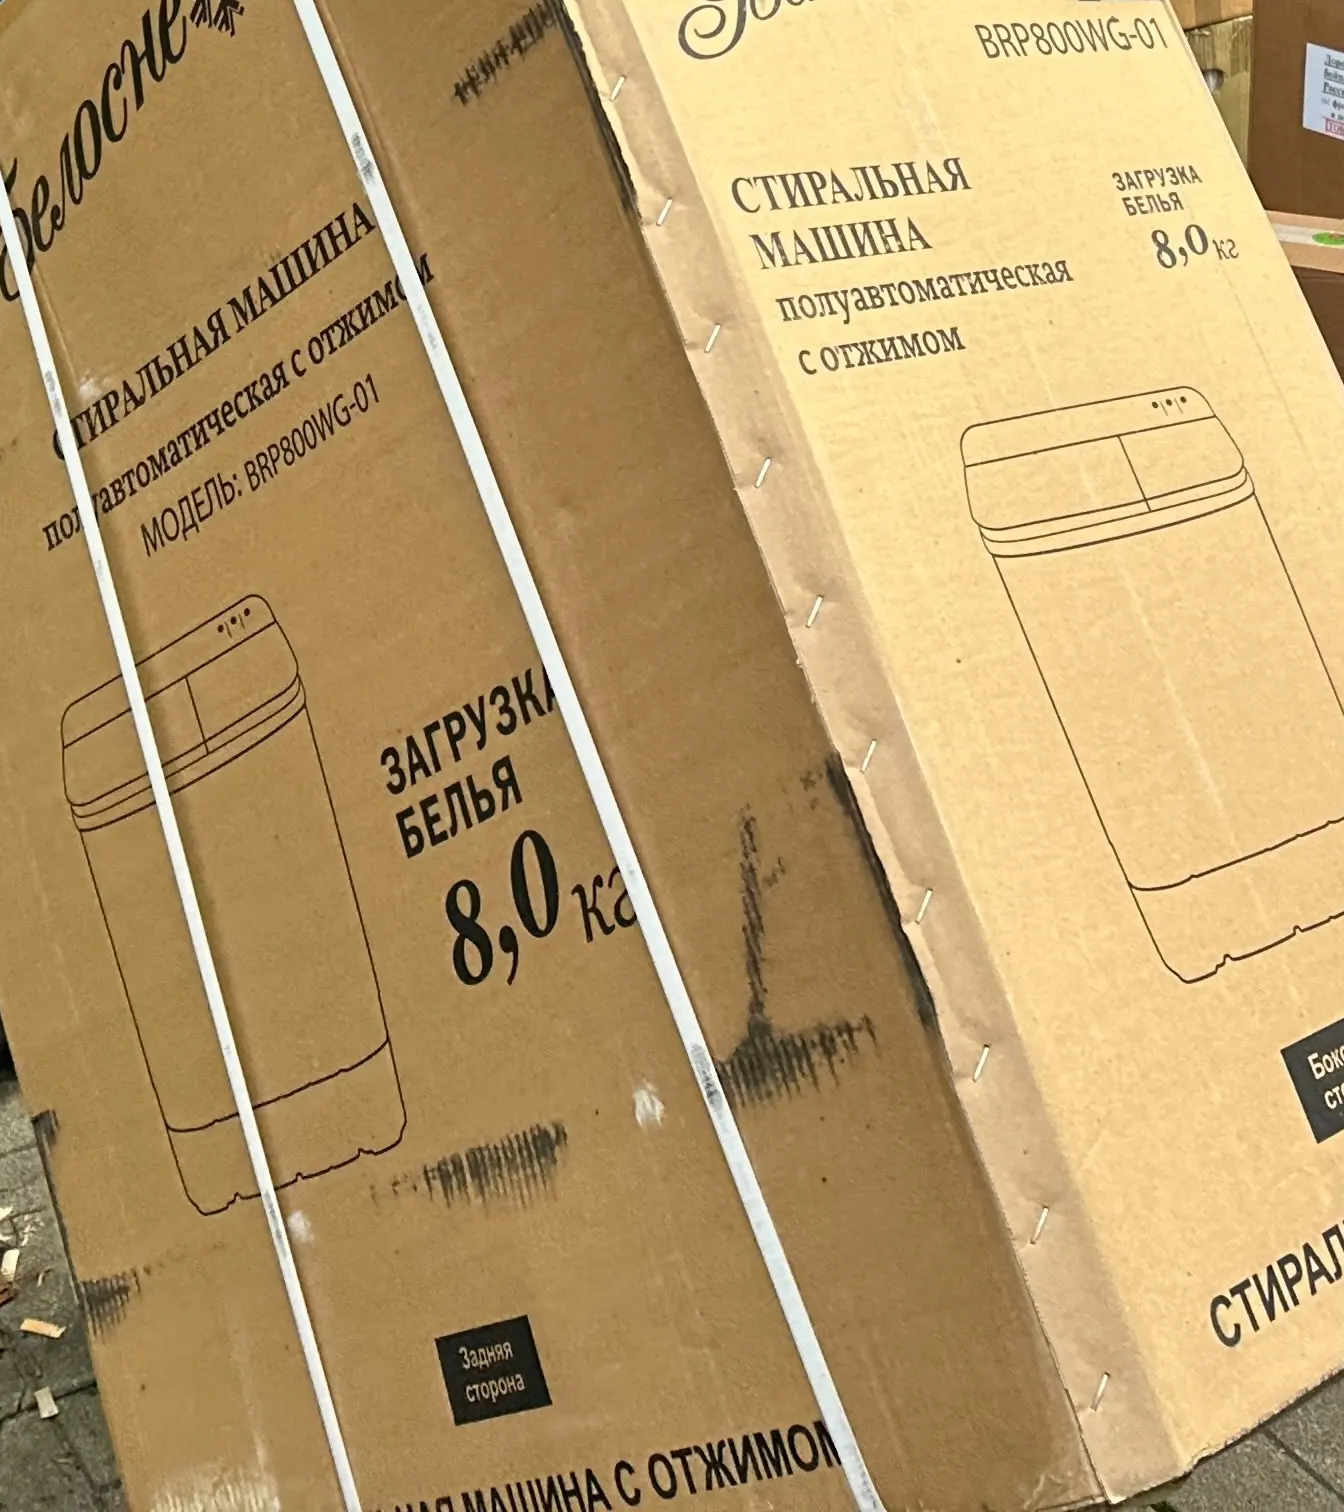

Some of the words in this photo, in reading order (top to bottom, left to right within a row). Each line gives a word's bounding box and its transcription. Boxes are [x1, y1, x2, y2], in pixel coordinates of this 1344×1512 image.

[975, 17, 1167, 59] BRP800WG-01
[731, 157, 972, 215] СТИРАЛЬНАЯ
[1111, 165, 1203, 193] ЗАГРУЗКА
[1121, 192, 1184, 217] БЕЛЬЯ
[234, 202, 375, 332] МАШИНА
[750, 216, 932, 270] МАШИНА
[1151, 223, 1209, 270] 8,0
[776, 255, 1074, 323] полуавтоматическая
[798, 347, 817, 376] с
[820, 324, 966, 372] отжимом
[42, 354, 290, 551] полавтоматическая
[139, 472, 243, 557] МОДЕЛЬ:
[245, 372, 381, 493] BRP800WG-01
[381, 664, 557, 795] ЗАГРУЗКА
[395, 756, 524, 858] БЕЛЬЯ
[444, 829, 558, 986] 8,0
[459, 1340, 513, 1370] Задняя
[465, 1372, 526, 1404] сторона
[613, 1460, 641, 1506] С
[648, 1420, 844, 1502] ОТЖИМОМ
